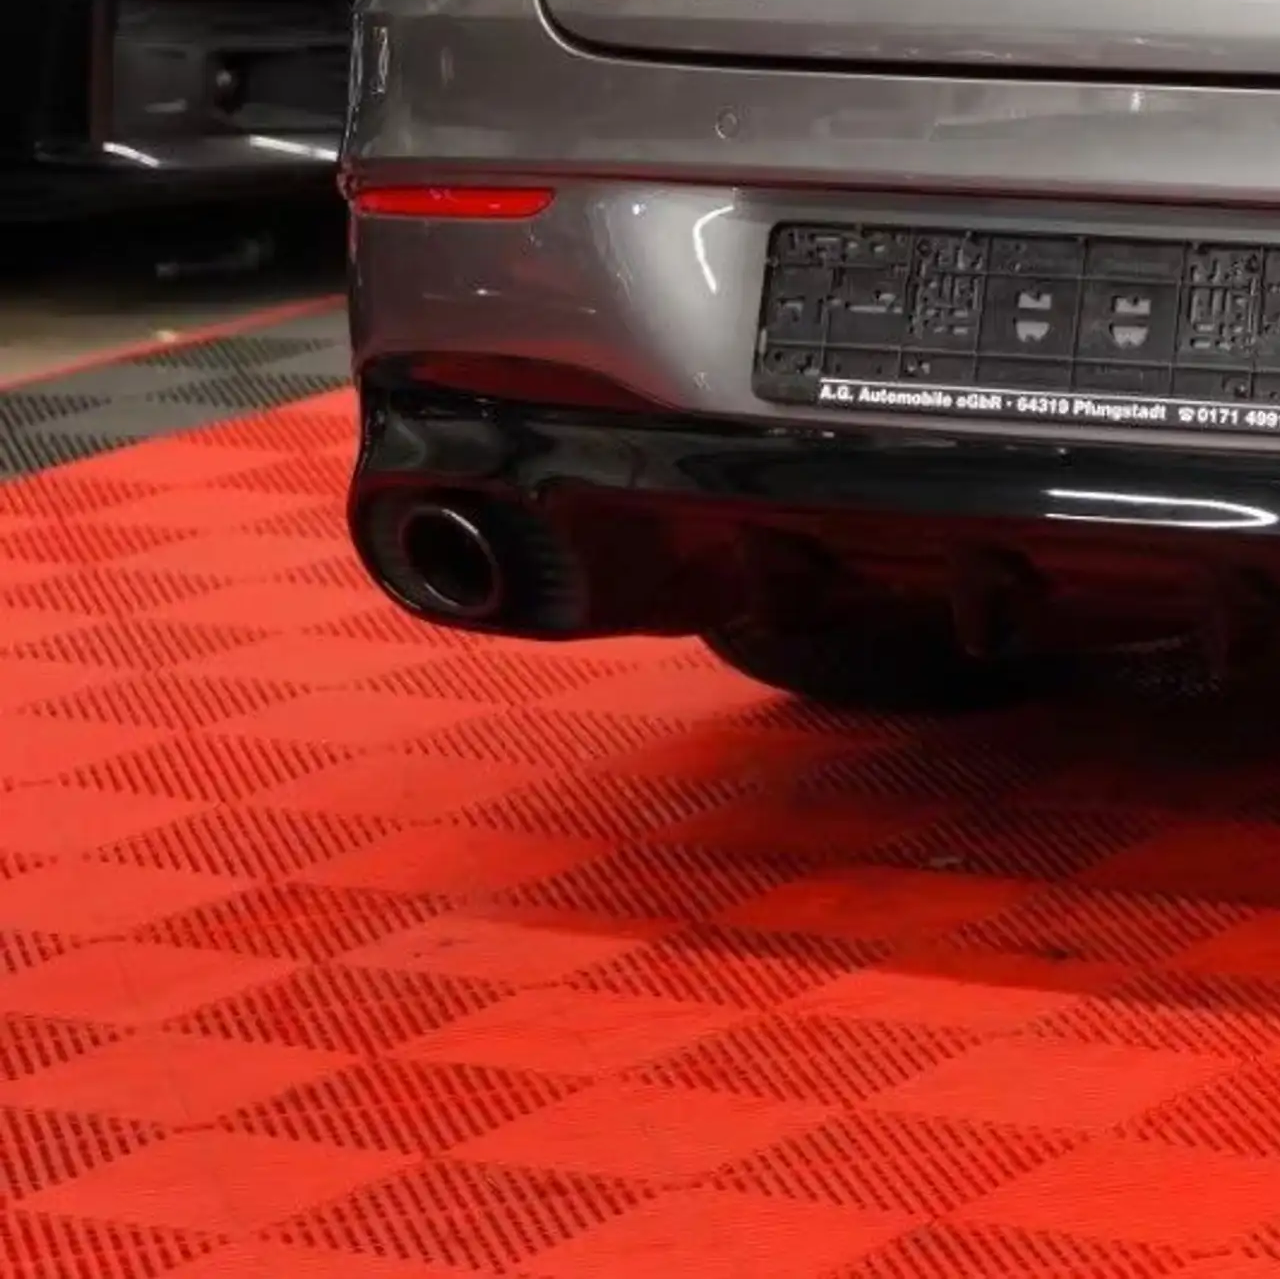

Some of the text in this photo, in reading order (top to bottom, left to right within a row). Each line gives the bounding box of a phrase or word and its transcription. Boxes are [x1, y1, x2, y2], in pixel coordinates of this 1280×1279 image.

[819, 384, 854, 403] A.G.
[858, 386, 953, 408] Automobile
[1016, 395, 1070, 415] 64319
[1072, 398, 1168, 421] Pfungstadt
[1197, 406, 1240, 426] 0171
